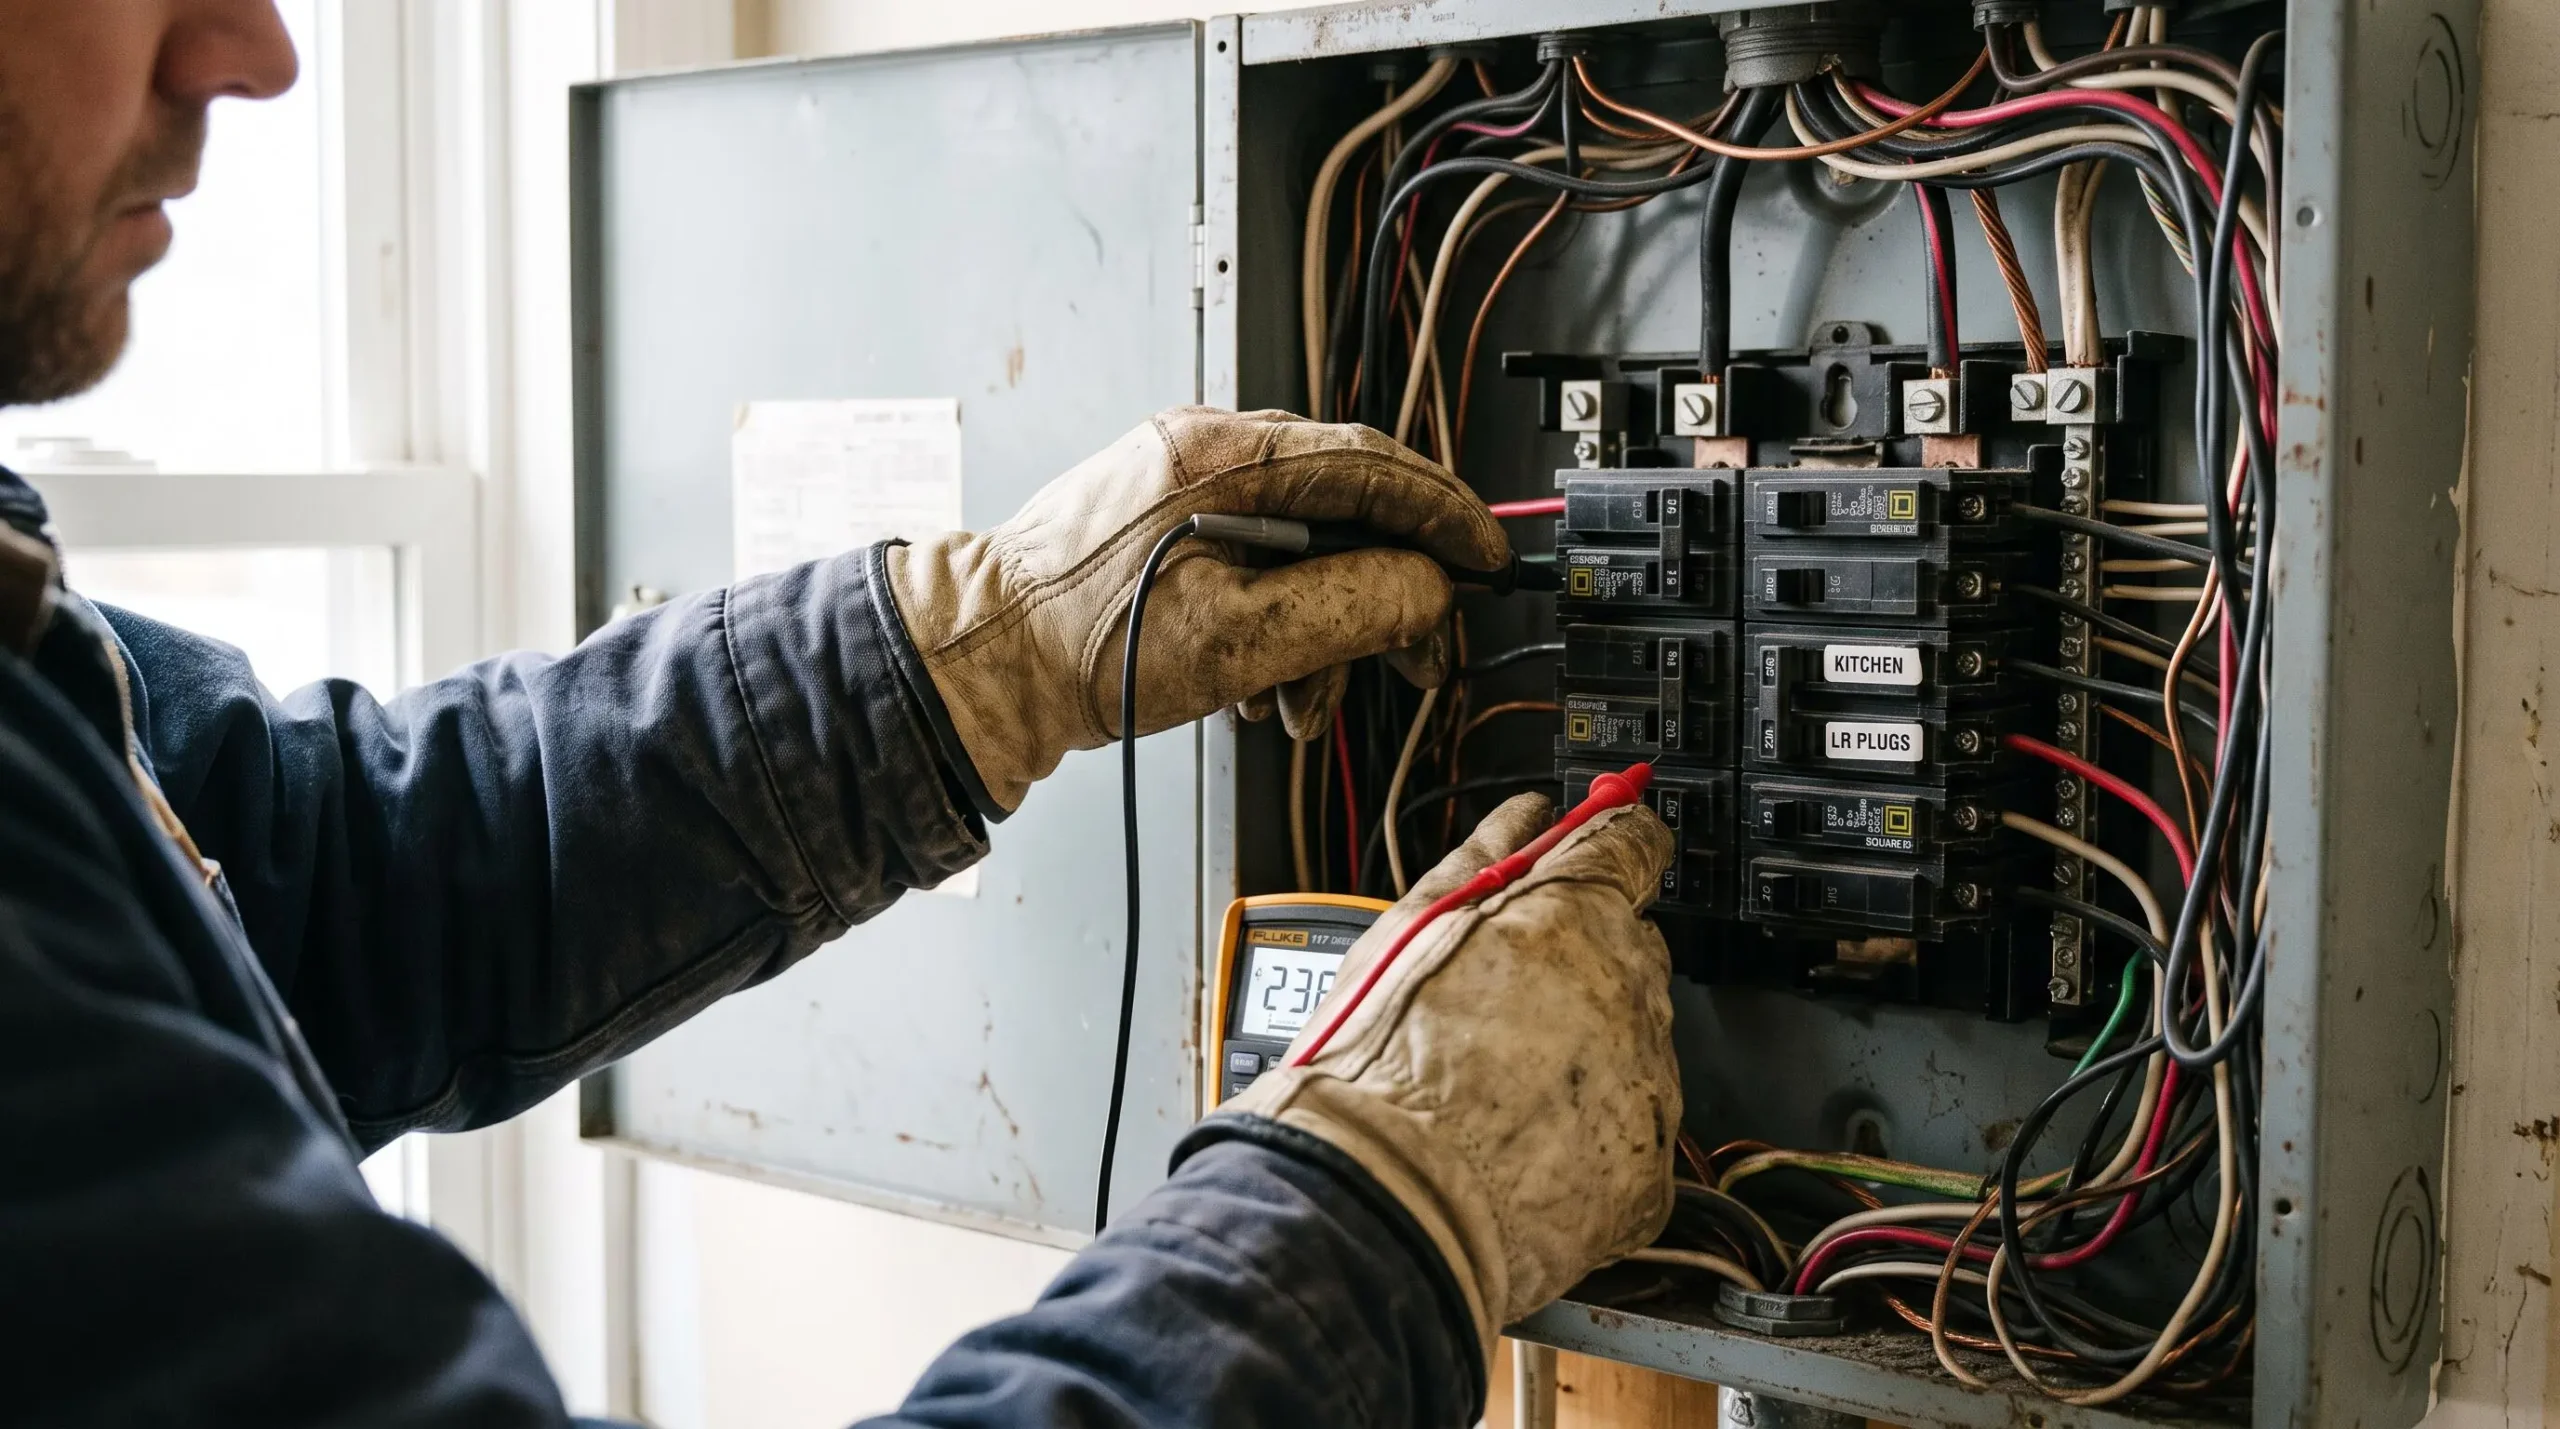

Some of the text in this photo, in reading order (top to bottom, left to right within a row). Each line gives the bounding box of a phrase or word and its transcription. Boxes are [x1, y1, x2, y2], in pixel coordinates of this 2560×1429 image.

[1835, 655, 1903, 674] KITCHEN
[1832, 732, 1910, 751] LR PLUGS
[1865, 837, 1902, 848] SQUARE
[1253, 931, 1304, 943] FLUKE
[1311, 935, 1329, 945] 117
